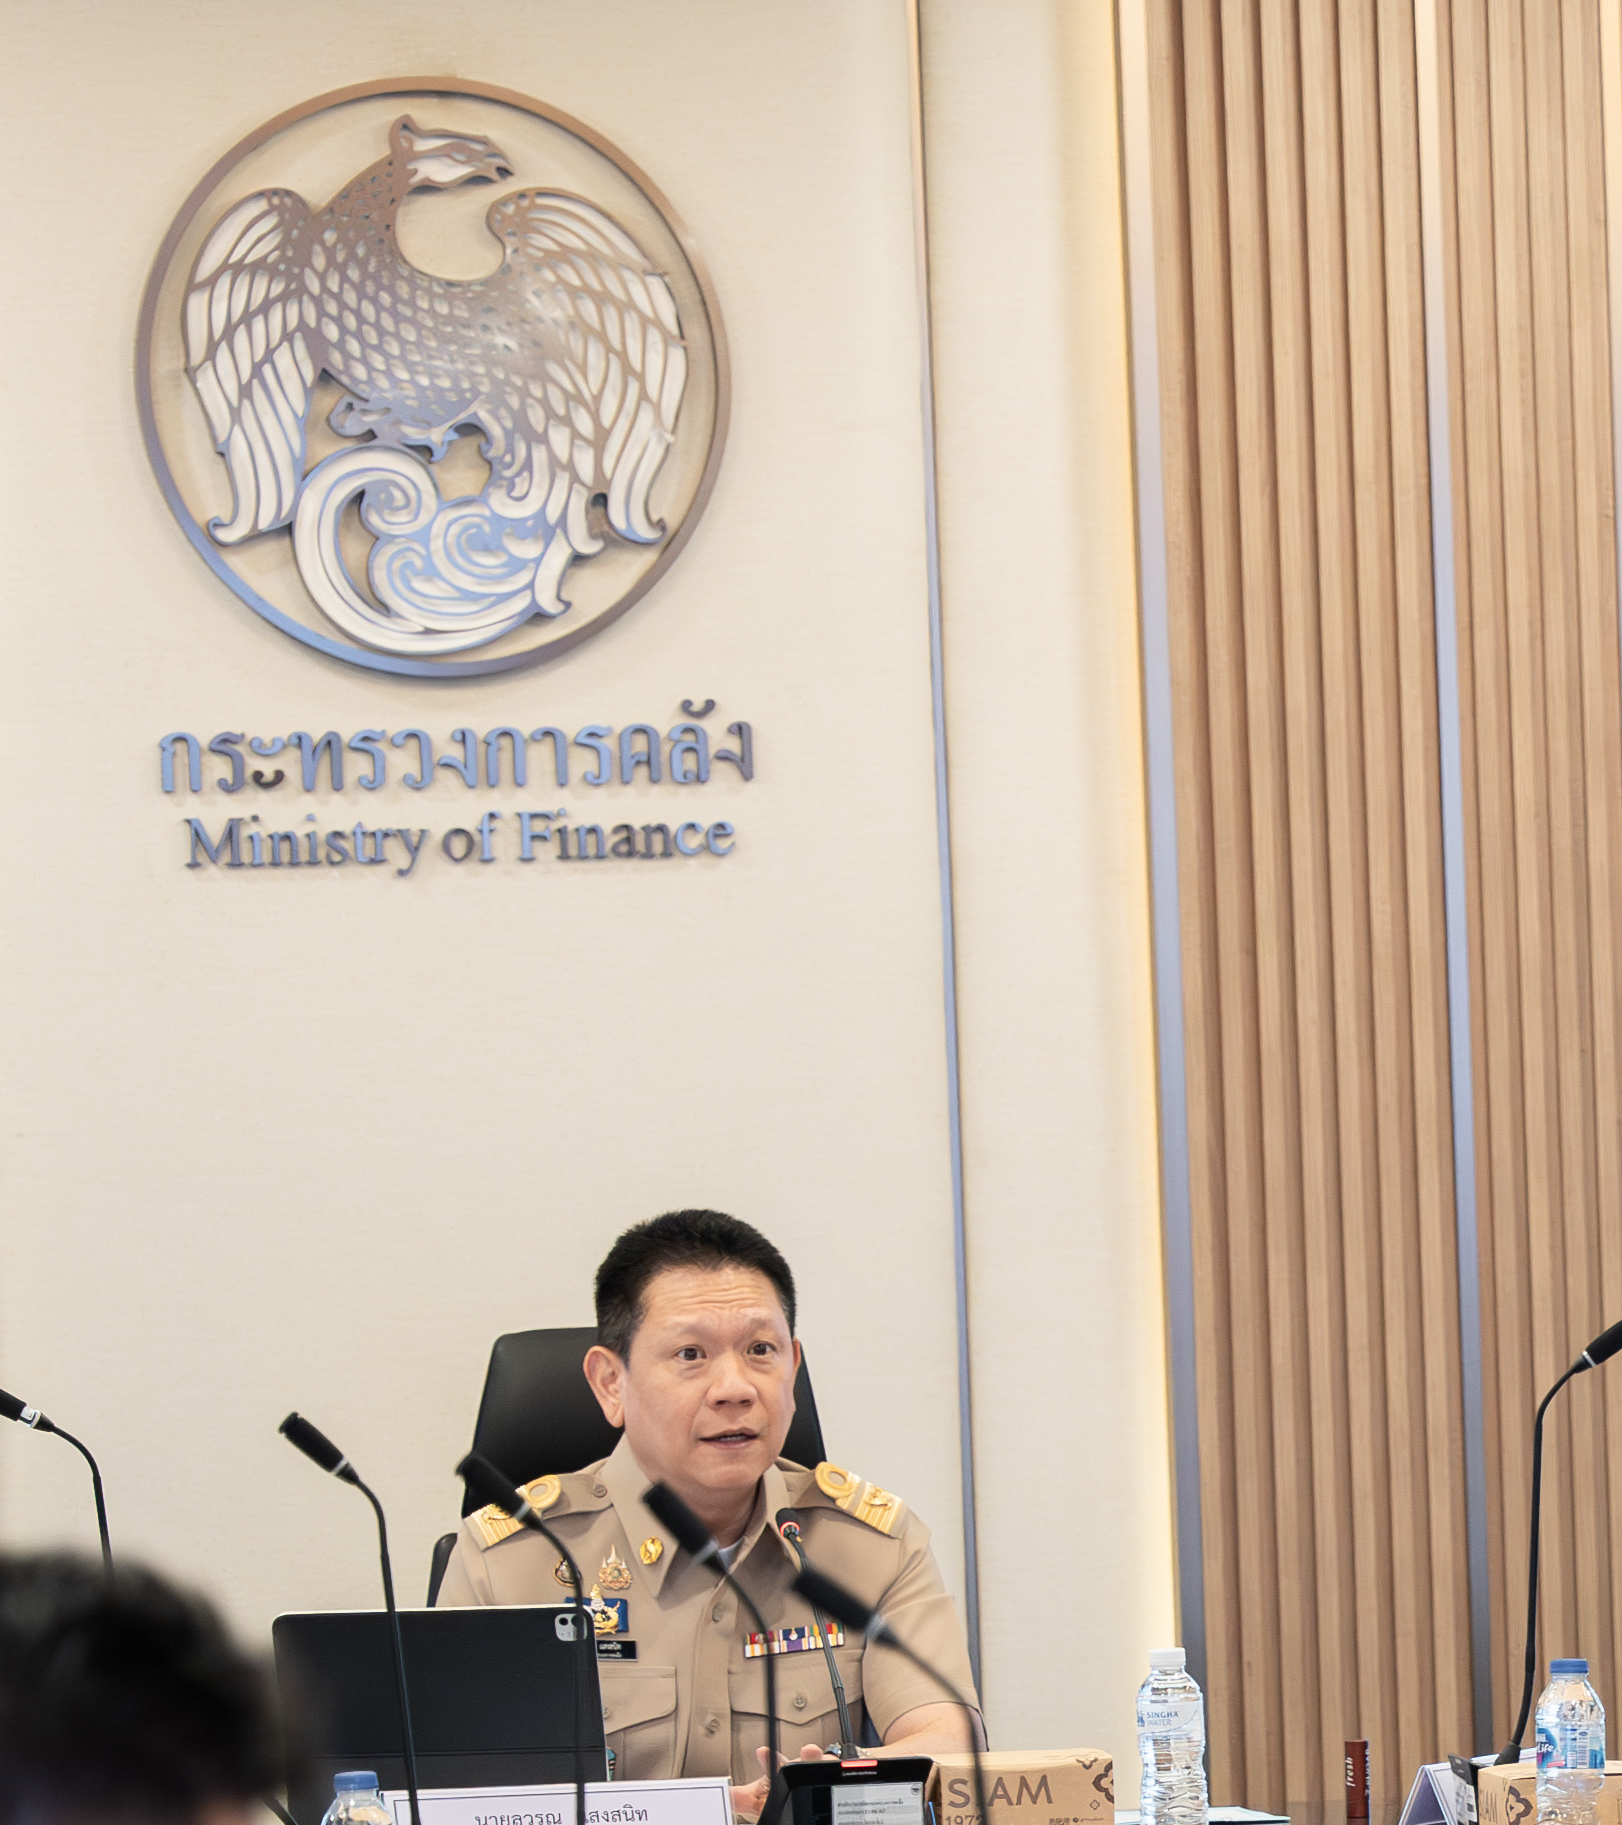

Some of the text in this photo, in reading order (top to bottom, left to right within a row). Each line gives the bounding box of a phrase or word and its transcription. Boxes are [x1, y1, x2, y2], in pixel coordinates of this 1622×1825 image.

[158, 698, 755, 793] กระทรวงการคลัง
[184, 808, 736, 877] Ministry of Finance
[1146, 1711, 1179, 1719] SINGHA
[1345, 1756, 1356, 1787] fresh
[947, 1774, 1054, 1809] SAM
[584, 1803, 649, 1824] สงสนิท
